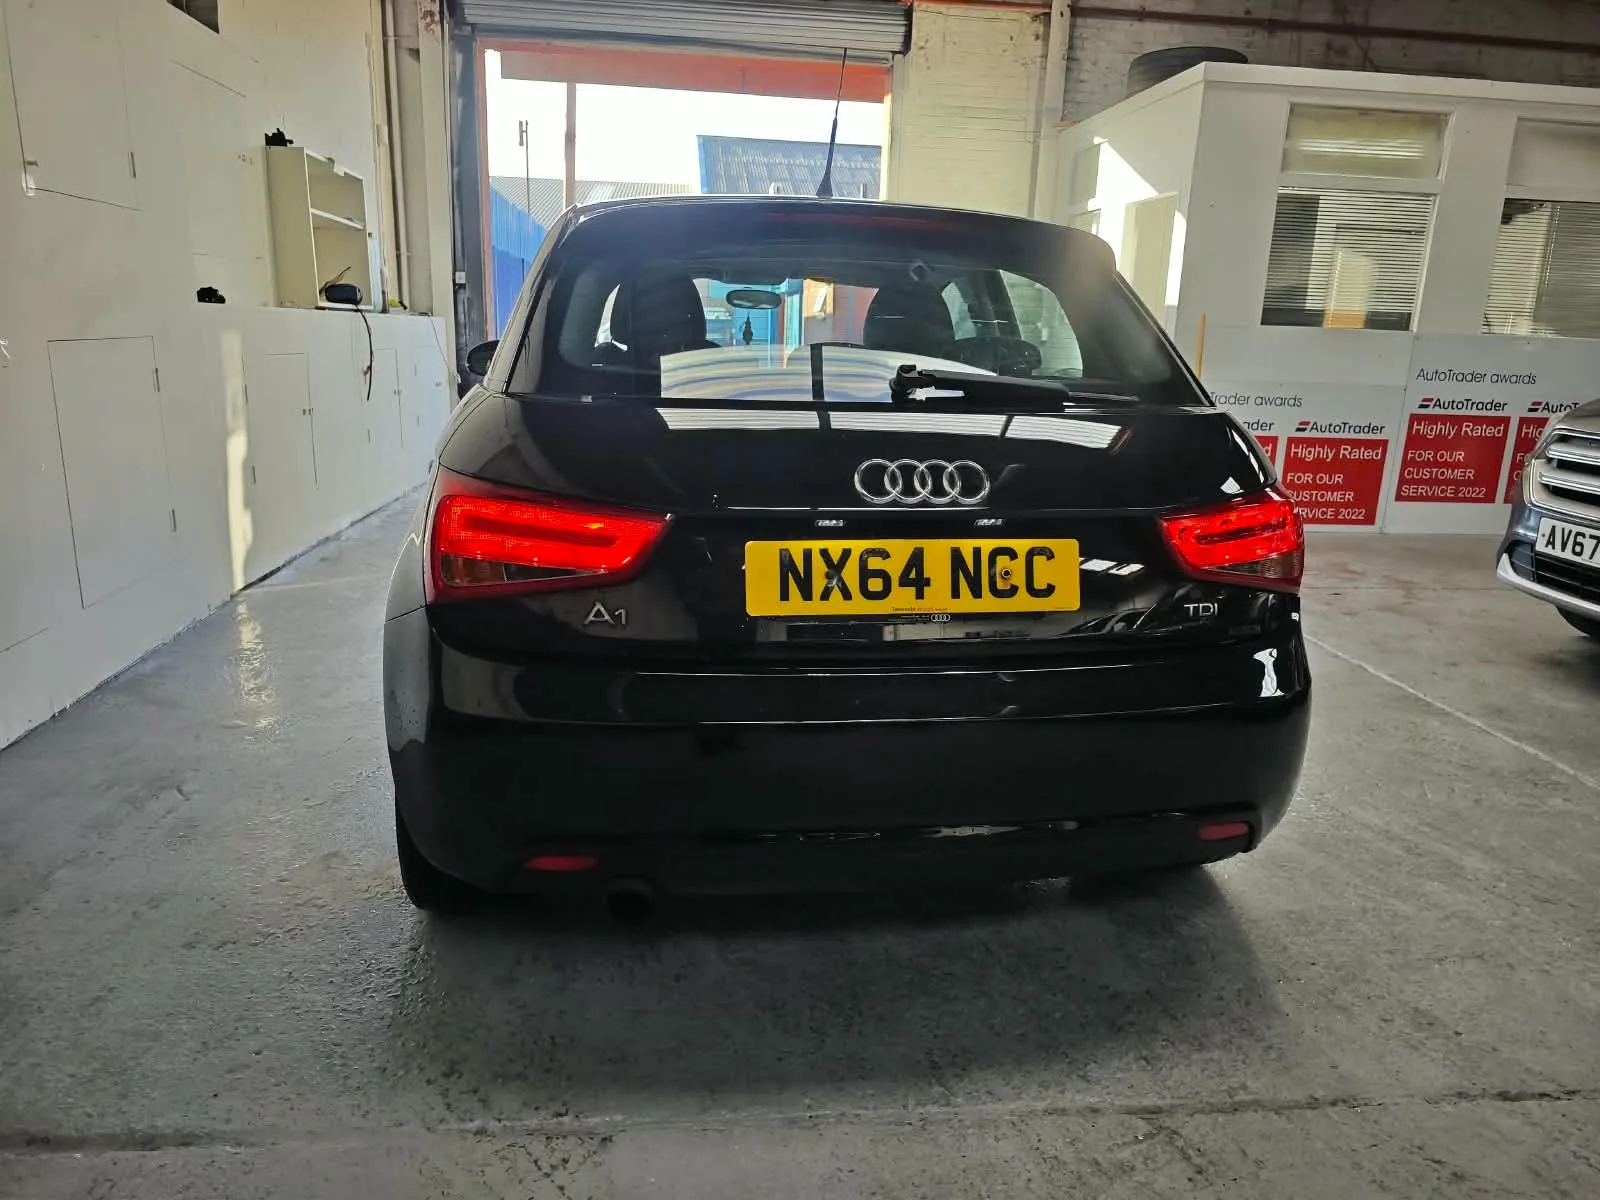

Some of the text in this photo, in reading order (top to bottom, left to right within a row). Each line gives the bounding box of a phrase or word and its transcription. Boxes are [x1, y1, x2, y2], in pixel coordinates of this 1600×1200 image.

[1416, 368, 1537, 385] AutoTrader awards
[1210, 392, 1303, 408] Trader awards
[1432, 398, 1508, 412] AutoTrader
[1309, 421, 1386, 435] AutoTrader
[1412, 420, 1504, 439] Highly Rated
[1290, 443, 1336, 461] Highly
[1340, 444, 1382, 460] Rated
[1407, 450, 1465, 462] FOR OUR
[1287, 472, 1344, 484] FOR OUR
[1404, 468, 1475, 480] CUSTOMER
[1400, 485, 1486, 498] SERVICE 2022
[1299, 508, 1366, 519] RVICE 2022
[1545, 525, 1600, 560] AV67
[779, 546, 1056, 601] NX64 NCC
[584, 602, 626, 625] A1
[1184, 603, 1218, 617] TDI
